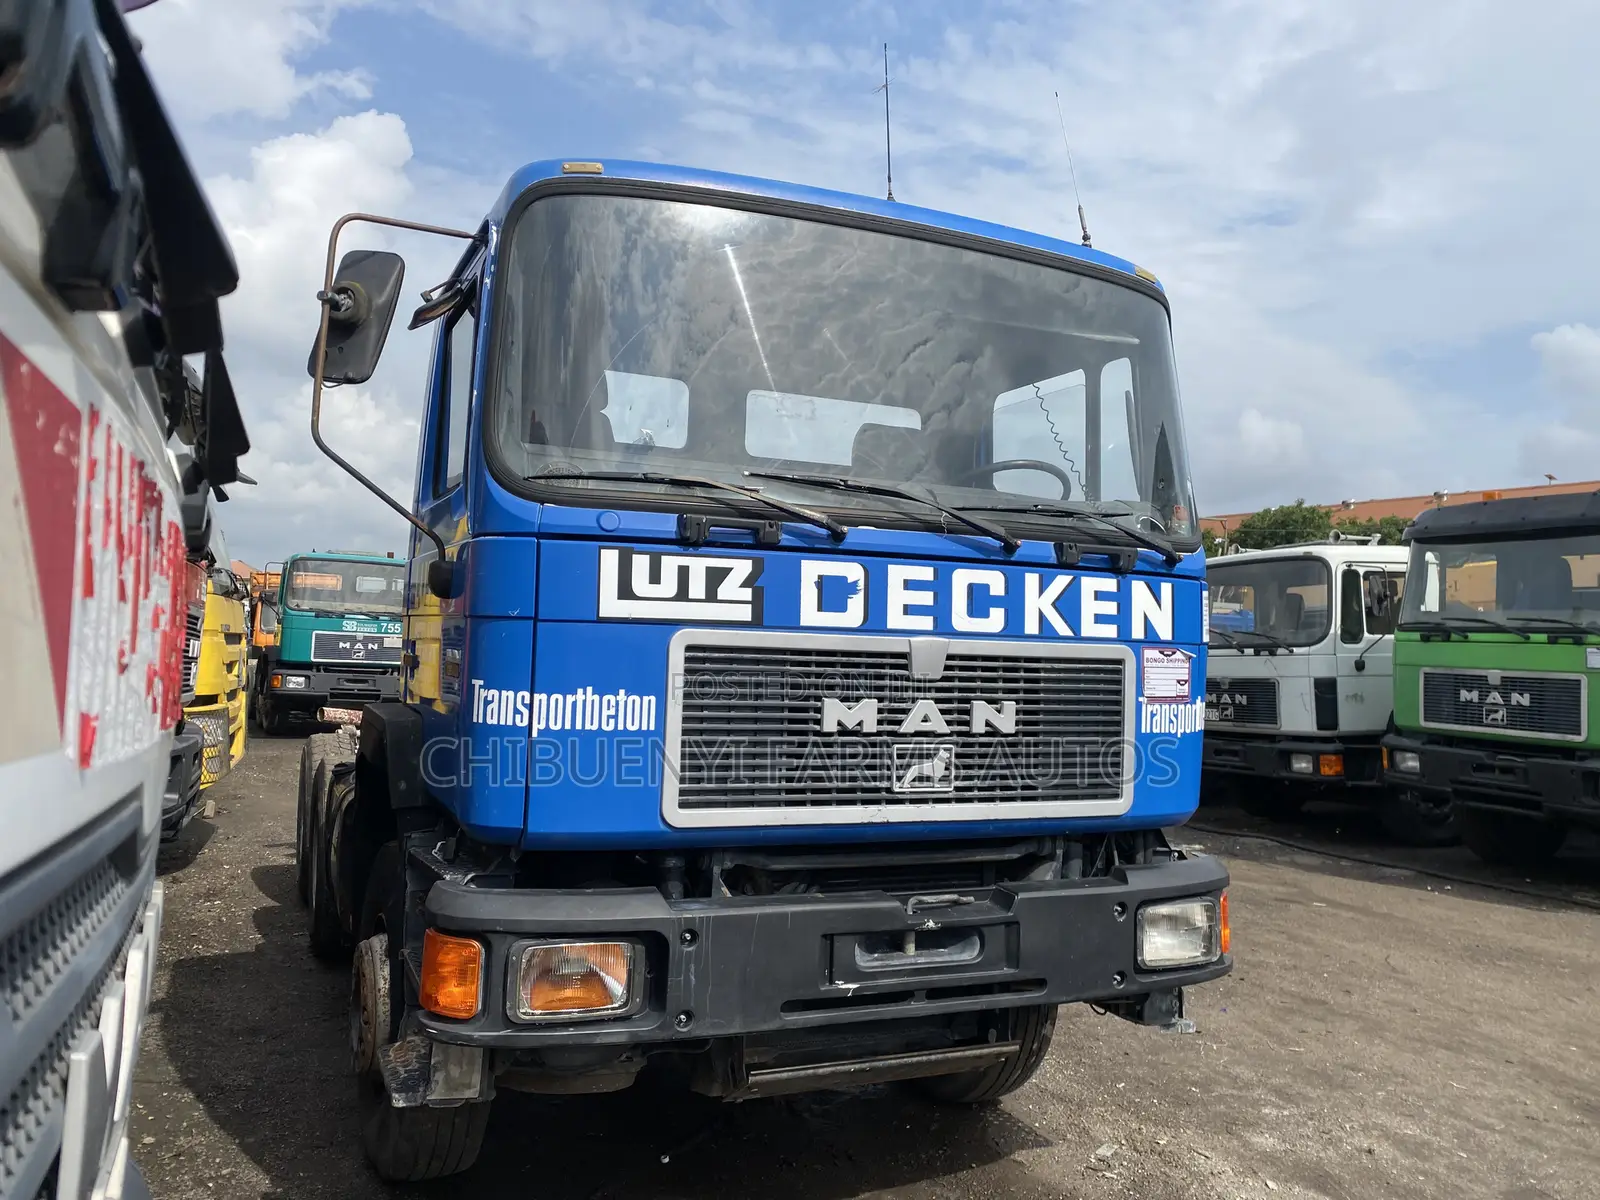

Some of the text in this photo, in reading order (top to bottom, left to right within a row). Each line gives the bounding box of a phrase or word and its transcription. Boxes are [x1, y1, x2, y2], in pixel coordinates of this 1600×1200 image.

[800, 559, 1175, 641] DECKEN
[380, 622, 401, 633] 755
[339, 642, 378, 650] MAN
[1205, 693, 1247, 705] MAN
[1460, 689, 1530, 706] MAN
[471, 679, 657, 738] Transportbeton
[819, 698, 1017, 735] MAN
